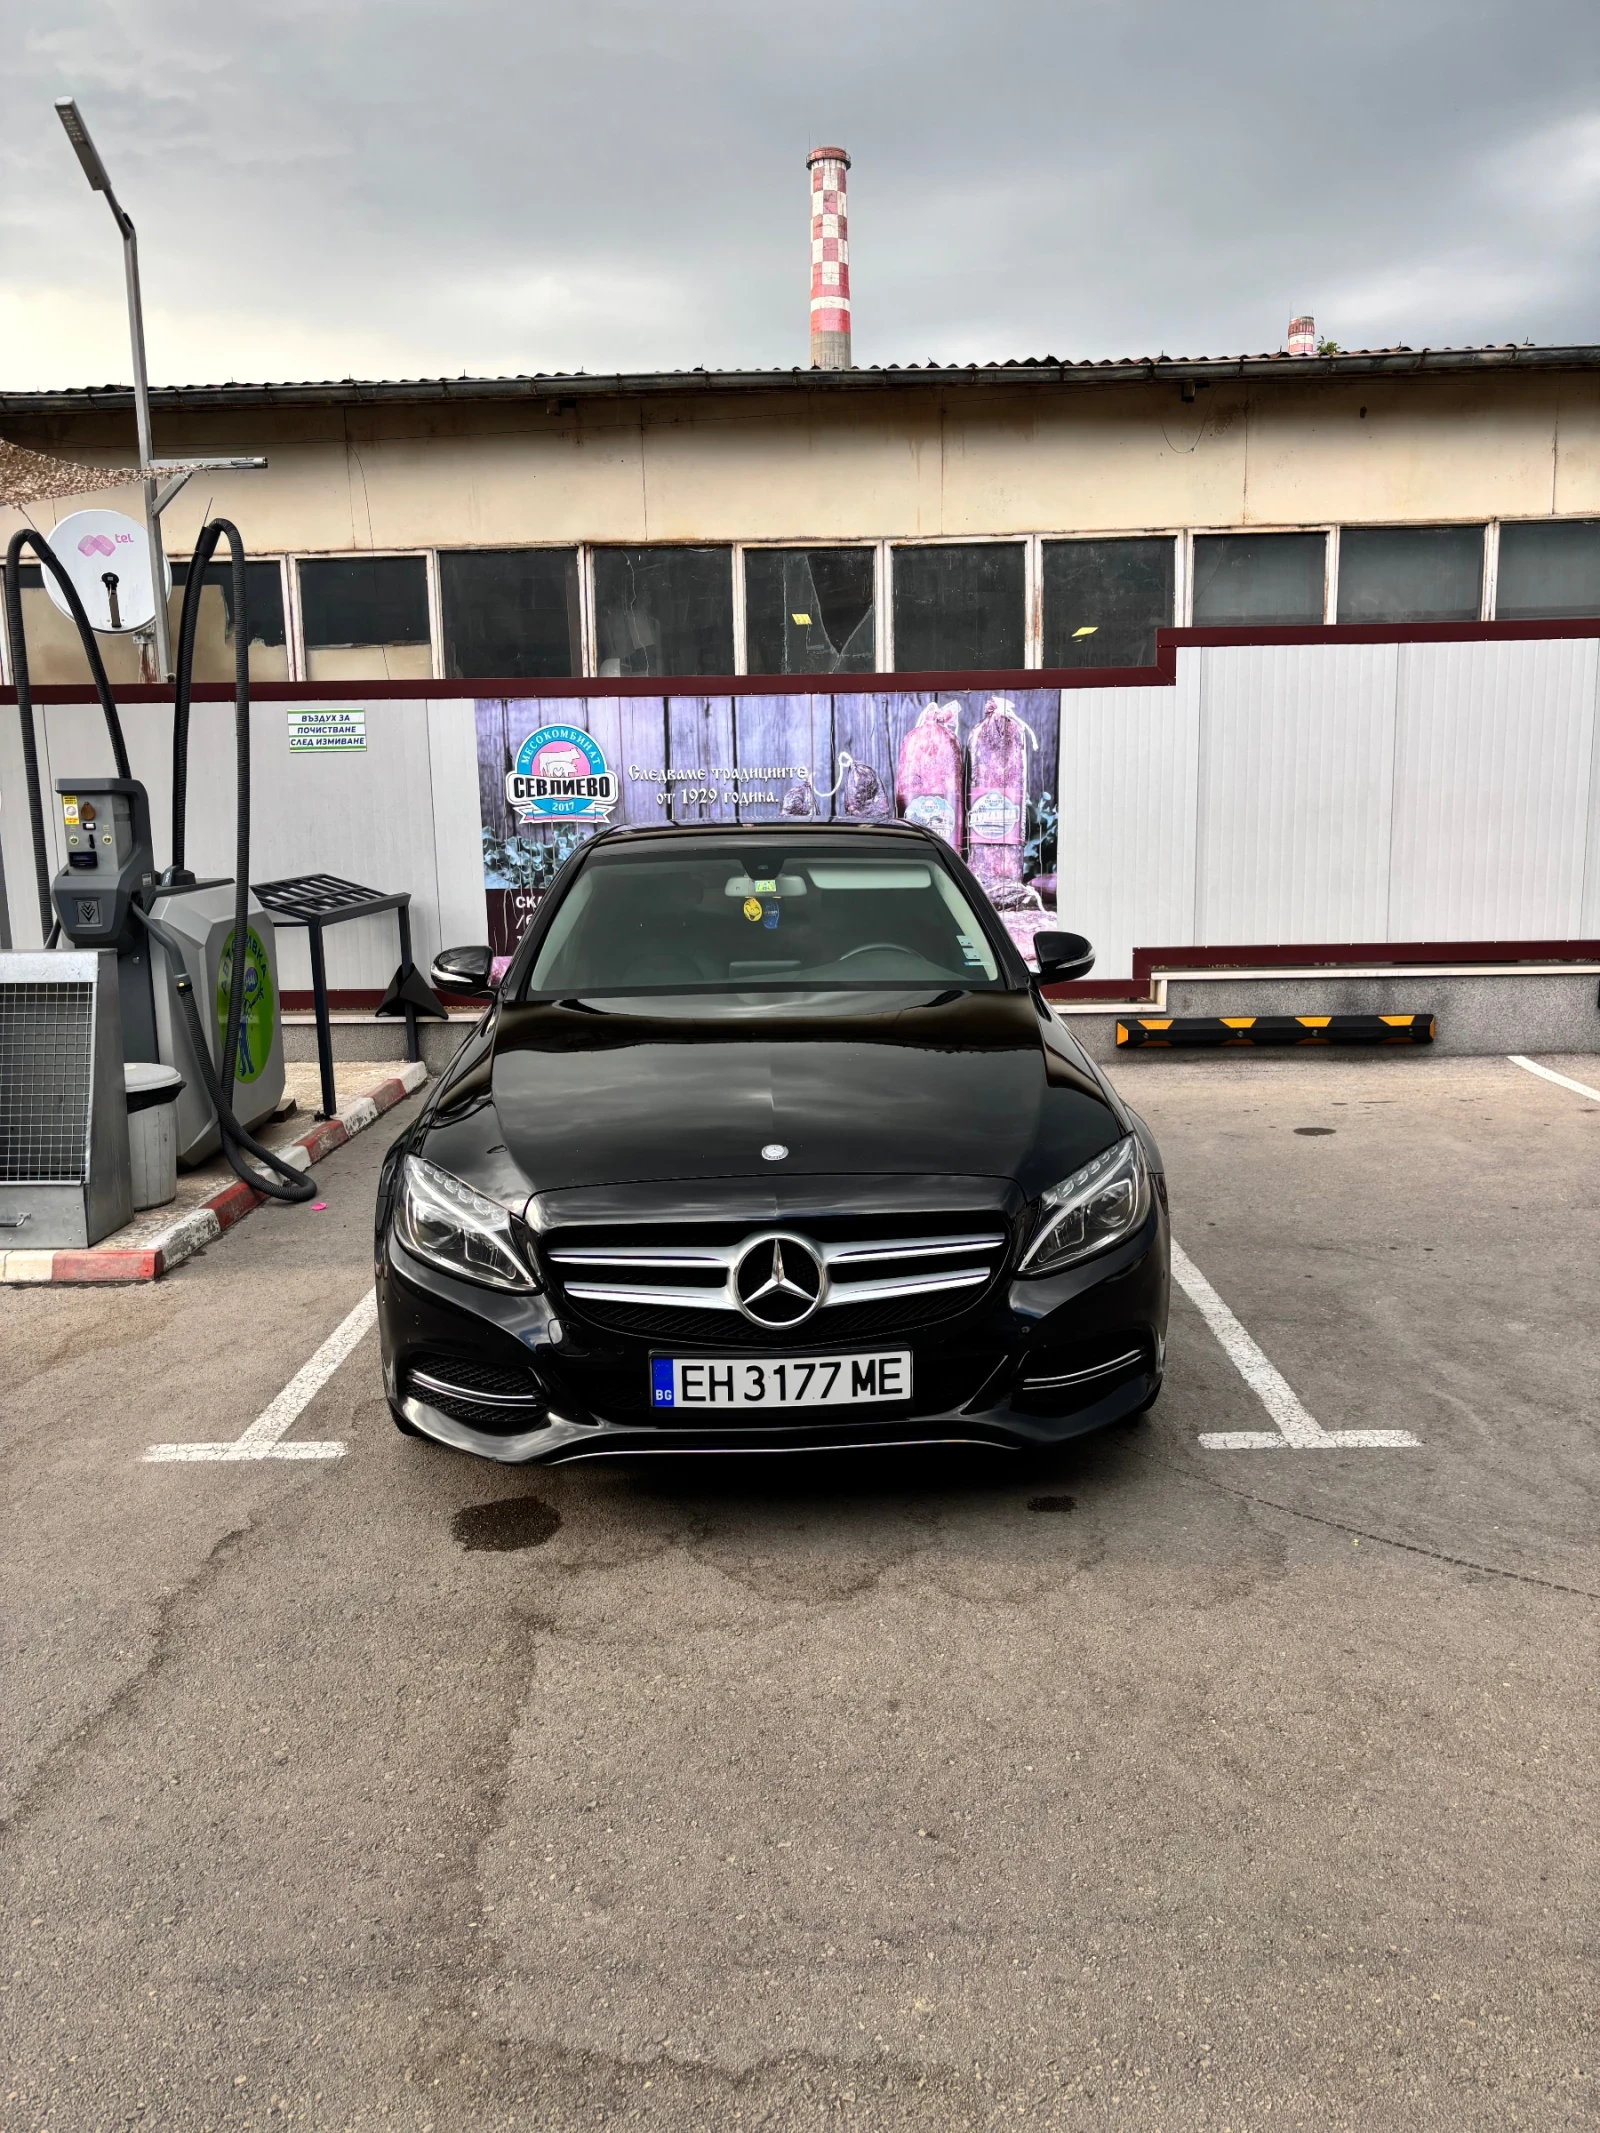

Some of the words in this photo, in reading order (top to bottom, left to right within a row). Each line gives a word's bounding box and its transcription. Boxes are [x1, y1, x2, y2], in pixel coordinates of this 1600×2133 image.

[301, 714, 337, 723] ВЪЗДУХ
[338, 714, 350, 722] ЗА
[297, 726, 357, 734] ПОЧИСТВАНЕ
[290, 738, 314, 746] СЛЕД
[315, 737, 365, 745] ИЗМИВАНЕ
[521, 729, 601, 765] МЕСОКОМБИНАТ
[628, 764, 706, 783] Следваме
[711, 766, 808, 784] традициите
[513, 776, 611, 799] СЕВЛИЕВО
[656, 793, 677, 805] от
[681, 788, 718, 805] 1929
[724, 791, 779, 806] година.
[552, 801, 575, 811] 2017
[681, 1365, 734, 1402] EH
[743, 1361, 842, 1402] 3177
[851, 1358, 903, 1398] ME
[655, 1389, 673, 1400] BG
